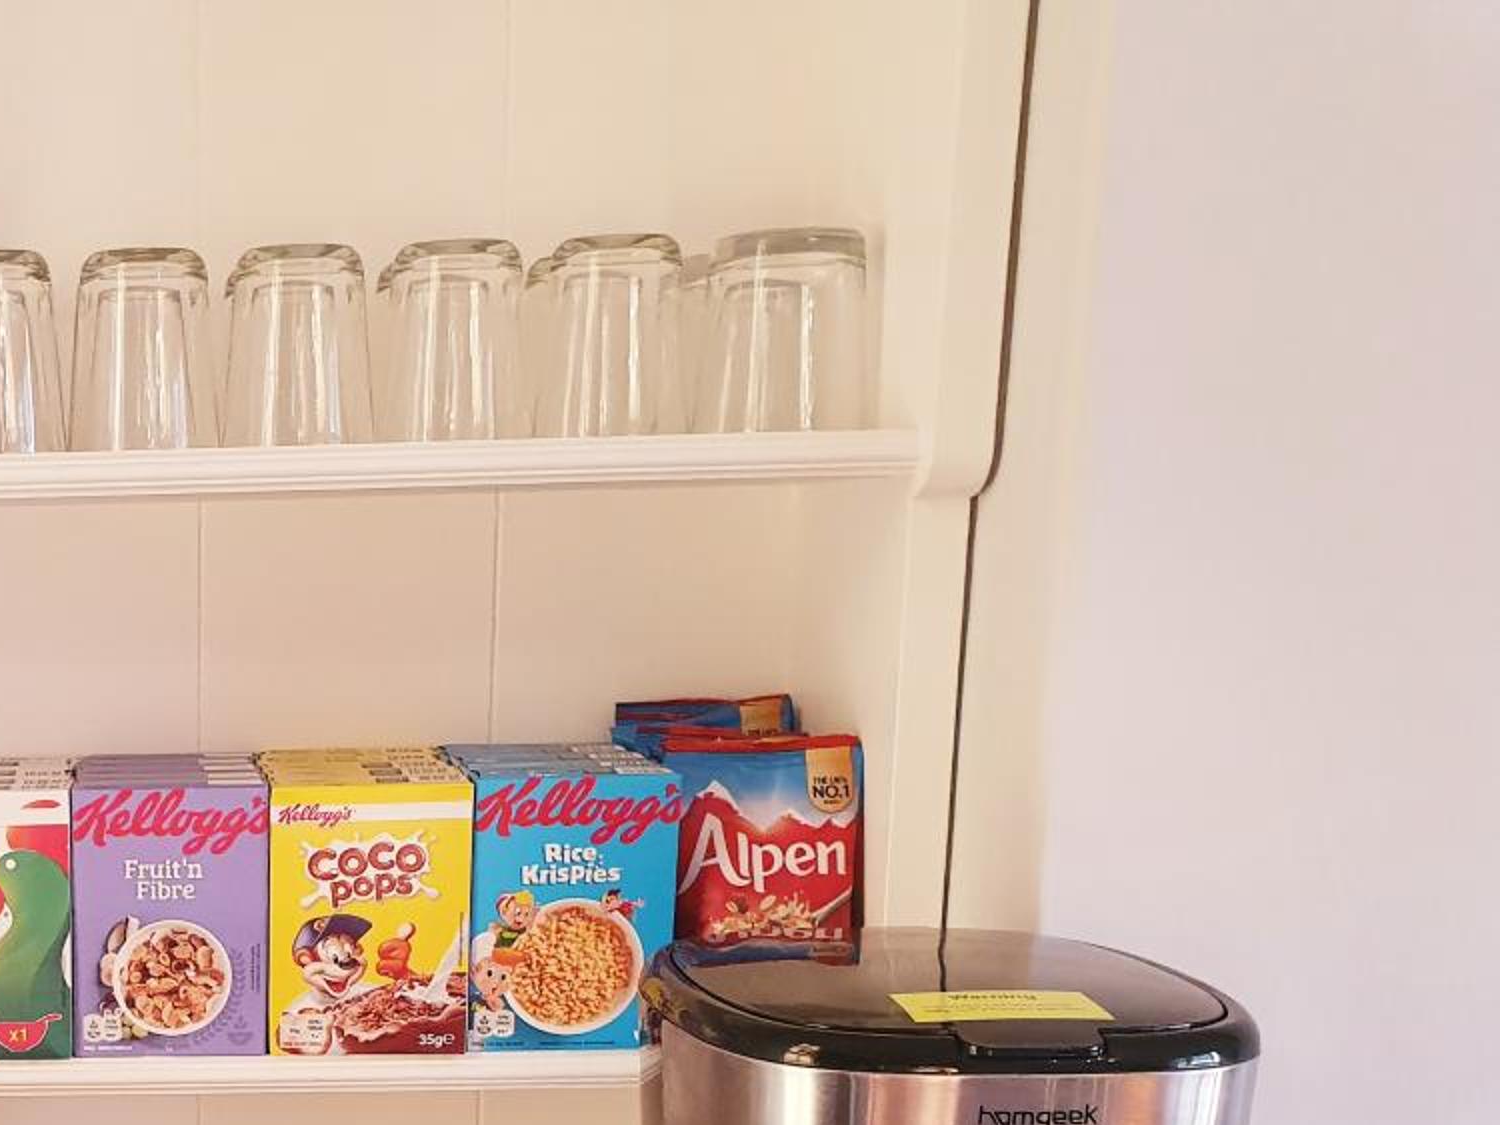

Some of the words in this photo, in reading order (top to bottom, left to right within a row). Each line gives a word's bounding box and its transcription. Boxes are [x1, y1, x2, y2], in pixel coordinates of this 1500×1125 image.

[72, 786, 269, 855] Kellogg's
[278, 803, 356, 827] Kellogg's
[475, 774, 685, 845] Kellogg's
[544, 843, 598, 864] Rice
[679, 813, 847, 893] Alpen
[136, 881, 196, 900] Fibre
